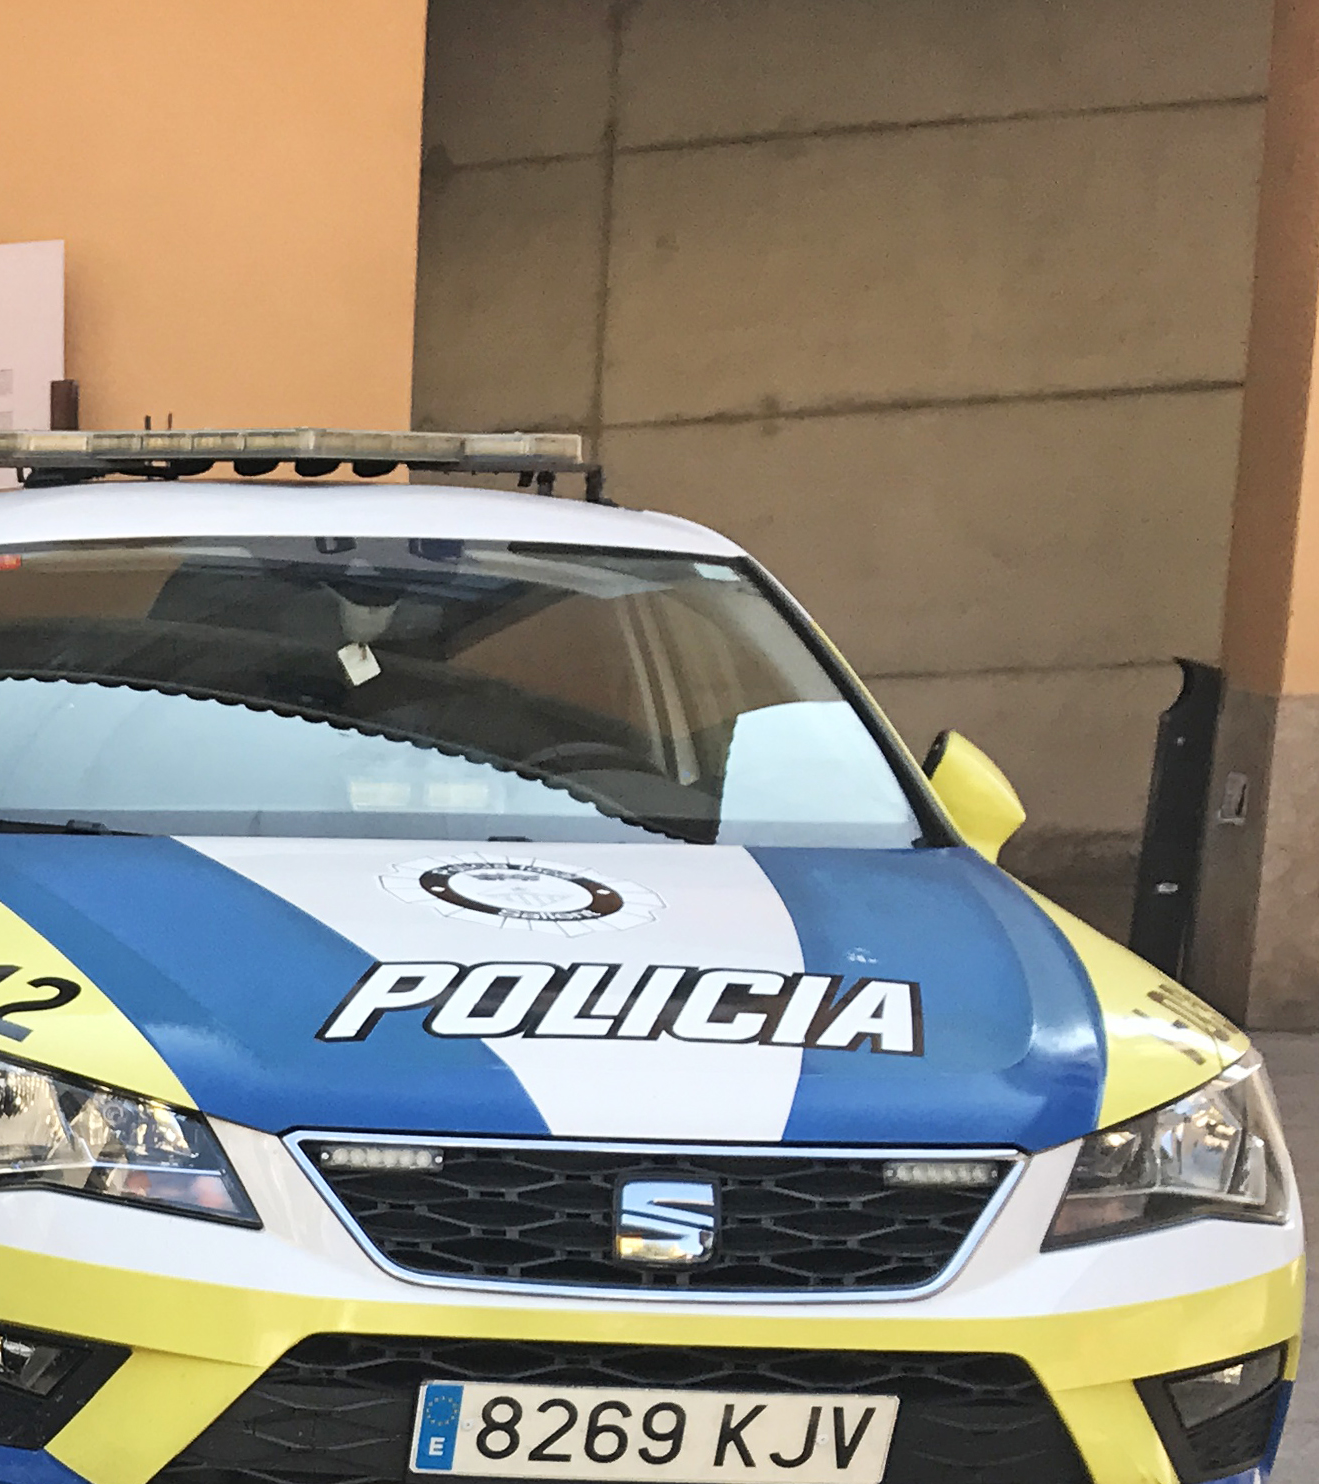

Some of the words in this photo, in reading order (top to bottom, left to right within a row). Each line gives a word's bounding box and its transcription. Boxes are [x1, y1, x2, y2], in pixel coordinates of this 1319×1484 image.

[314, 960, 925, 1057] POLICIA
[428, 1436, 446, 1455] E
[475, 1396, 687, 1465] 8269
[712, 1403, 877, 1470] KJV
